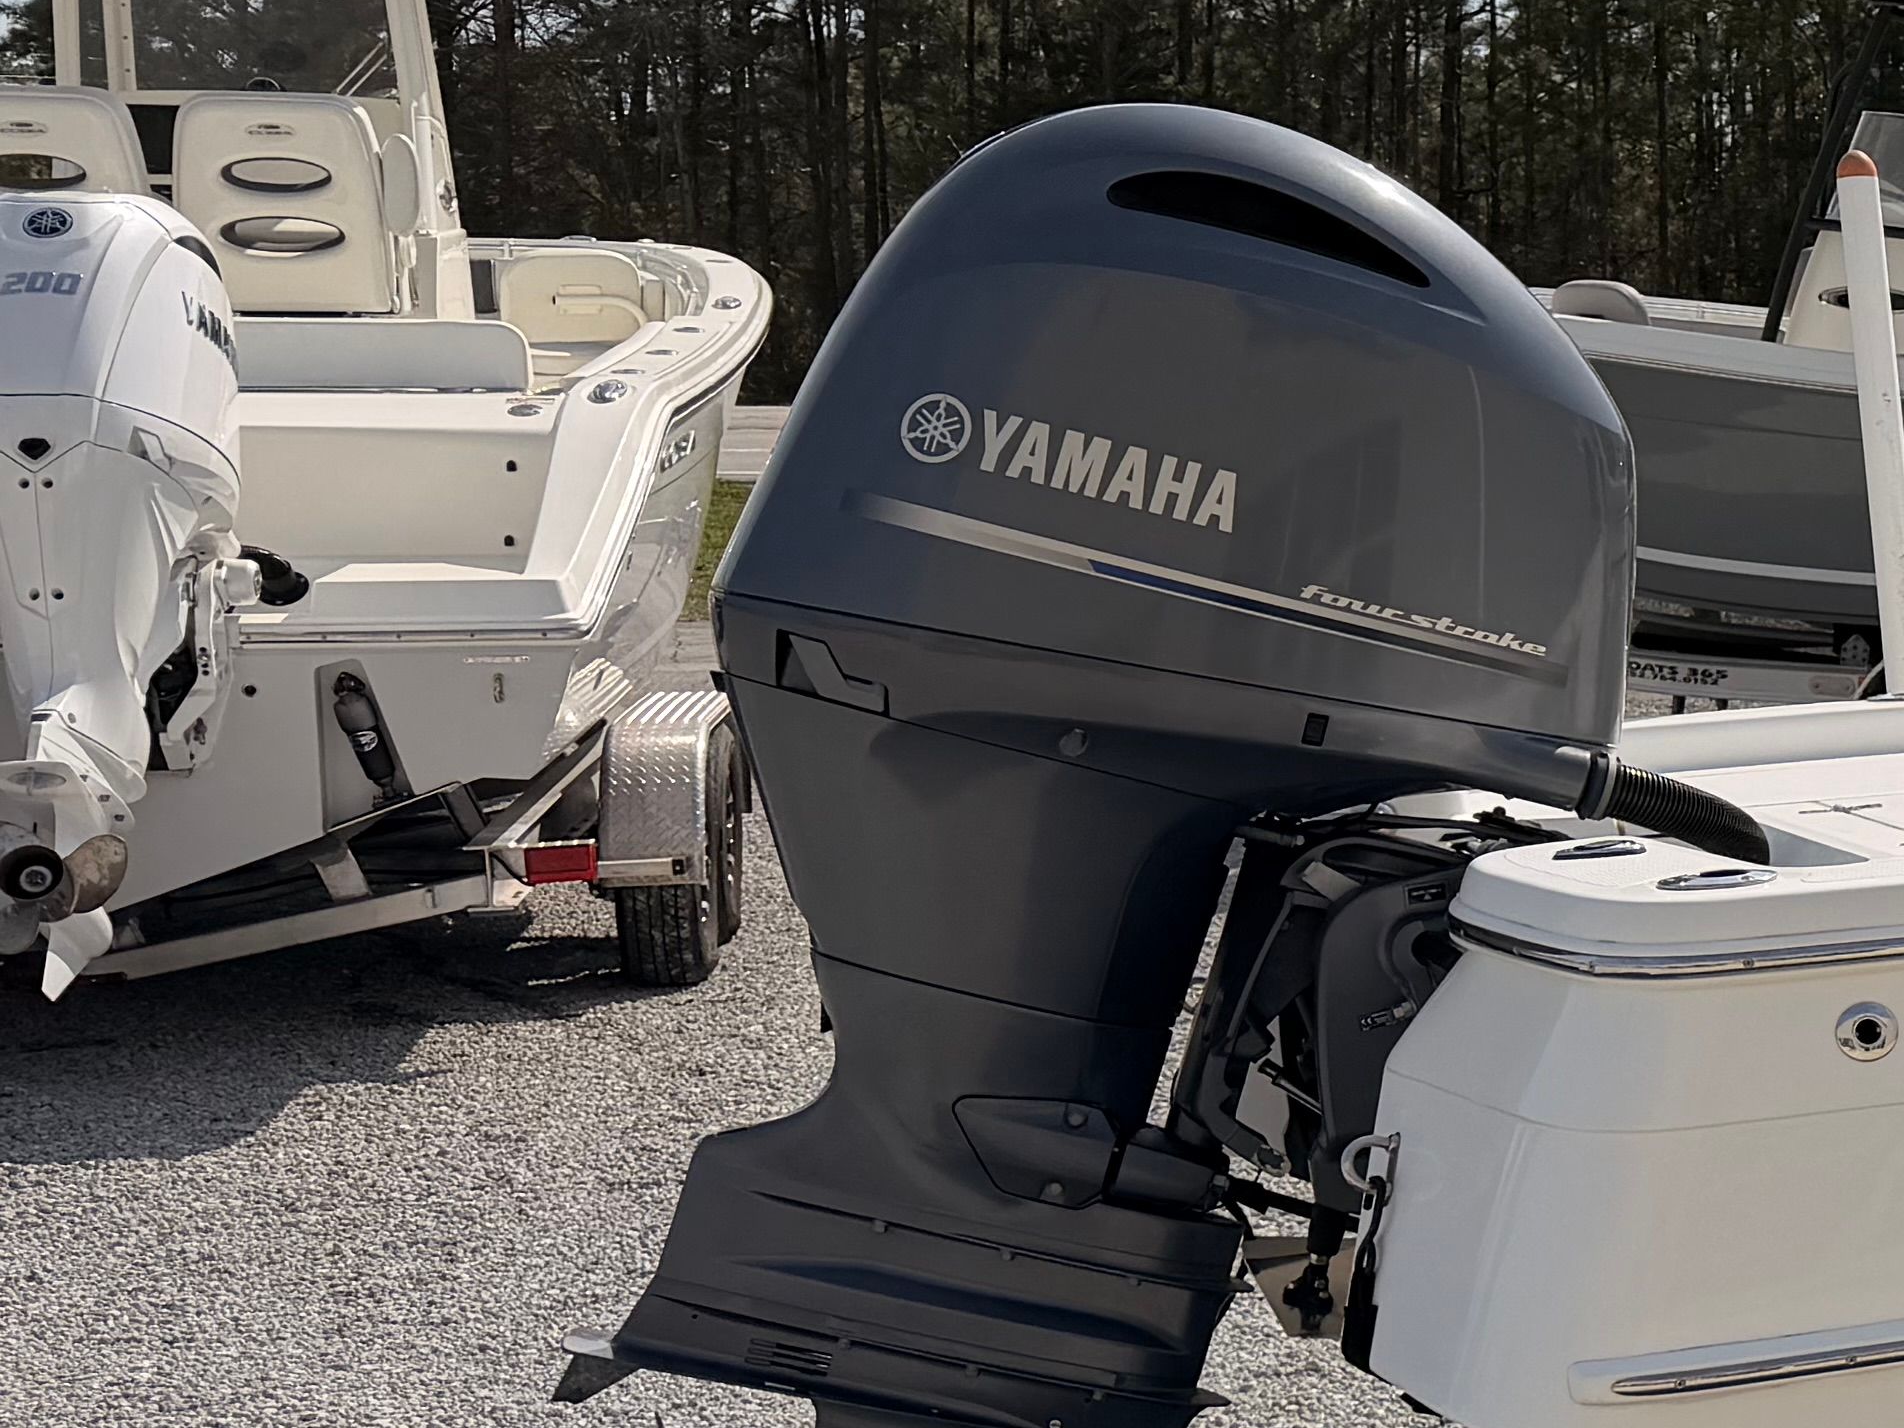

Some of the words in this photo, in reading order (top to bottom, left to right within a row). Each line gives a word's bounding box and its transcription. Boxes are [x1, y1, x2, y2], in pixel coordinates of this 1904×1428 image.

[0, 271, 83, 296] 200
[979, 408, 1237, 534] YAMAHA
[1300, 584, 1404, 619] four
[1400, 615, 1547, 658] stroke
[1627, 661, 1679, 677] OATS
[1687, 667, 1728, 679] 365
